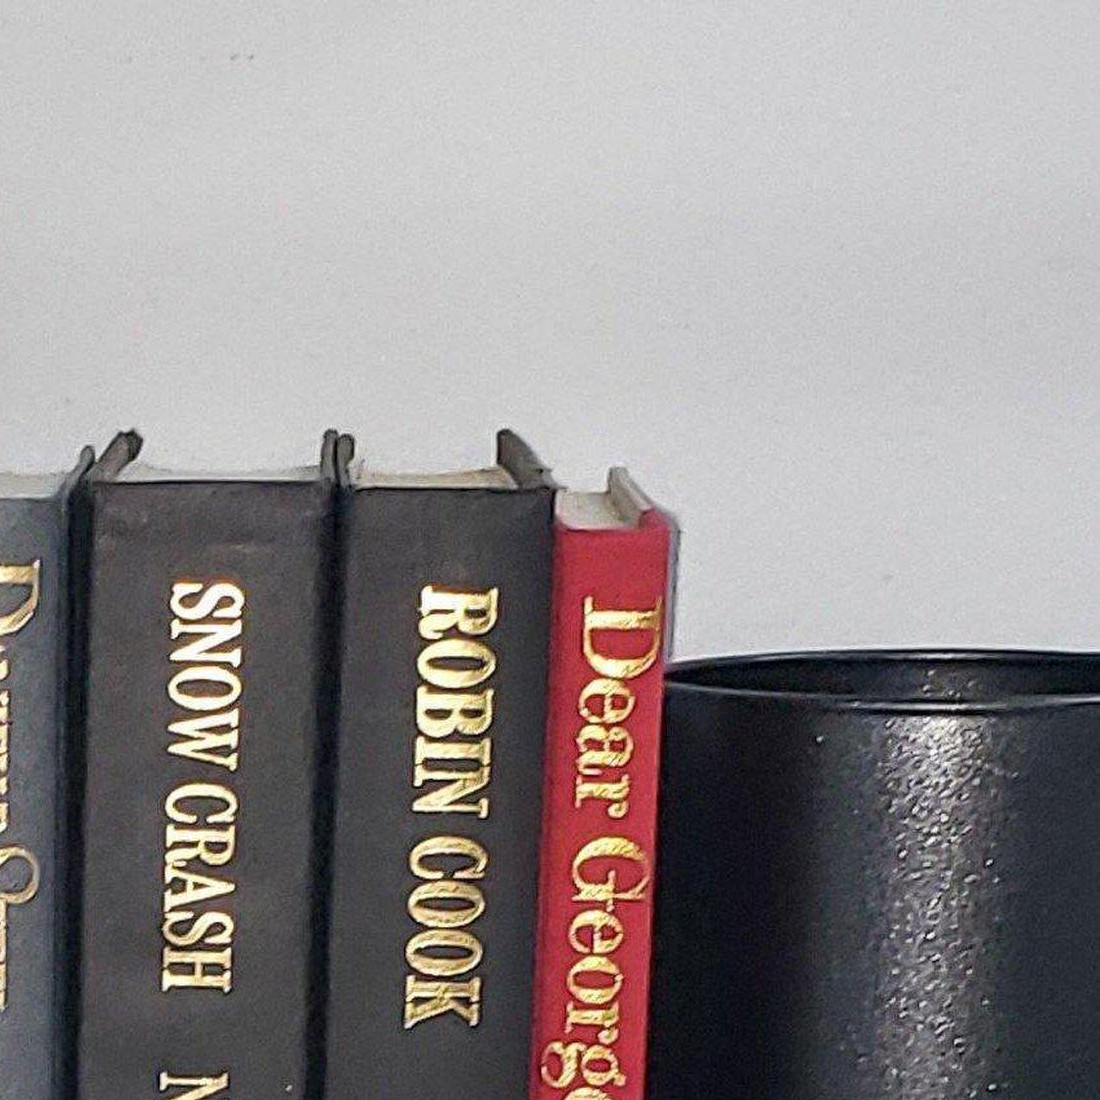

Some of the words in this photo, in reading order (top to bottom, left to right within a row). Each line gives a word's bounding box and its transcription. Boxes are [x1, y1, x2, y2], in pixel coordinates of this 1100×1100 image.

[168, 583, 245, 771] SNOW
[412, 585, 498, 818] ROBIN
[575, 596, 662, 818] Dear
[162, 783, 237, 992] CRASH
[404, 837, 487, 1029] COOK
